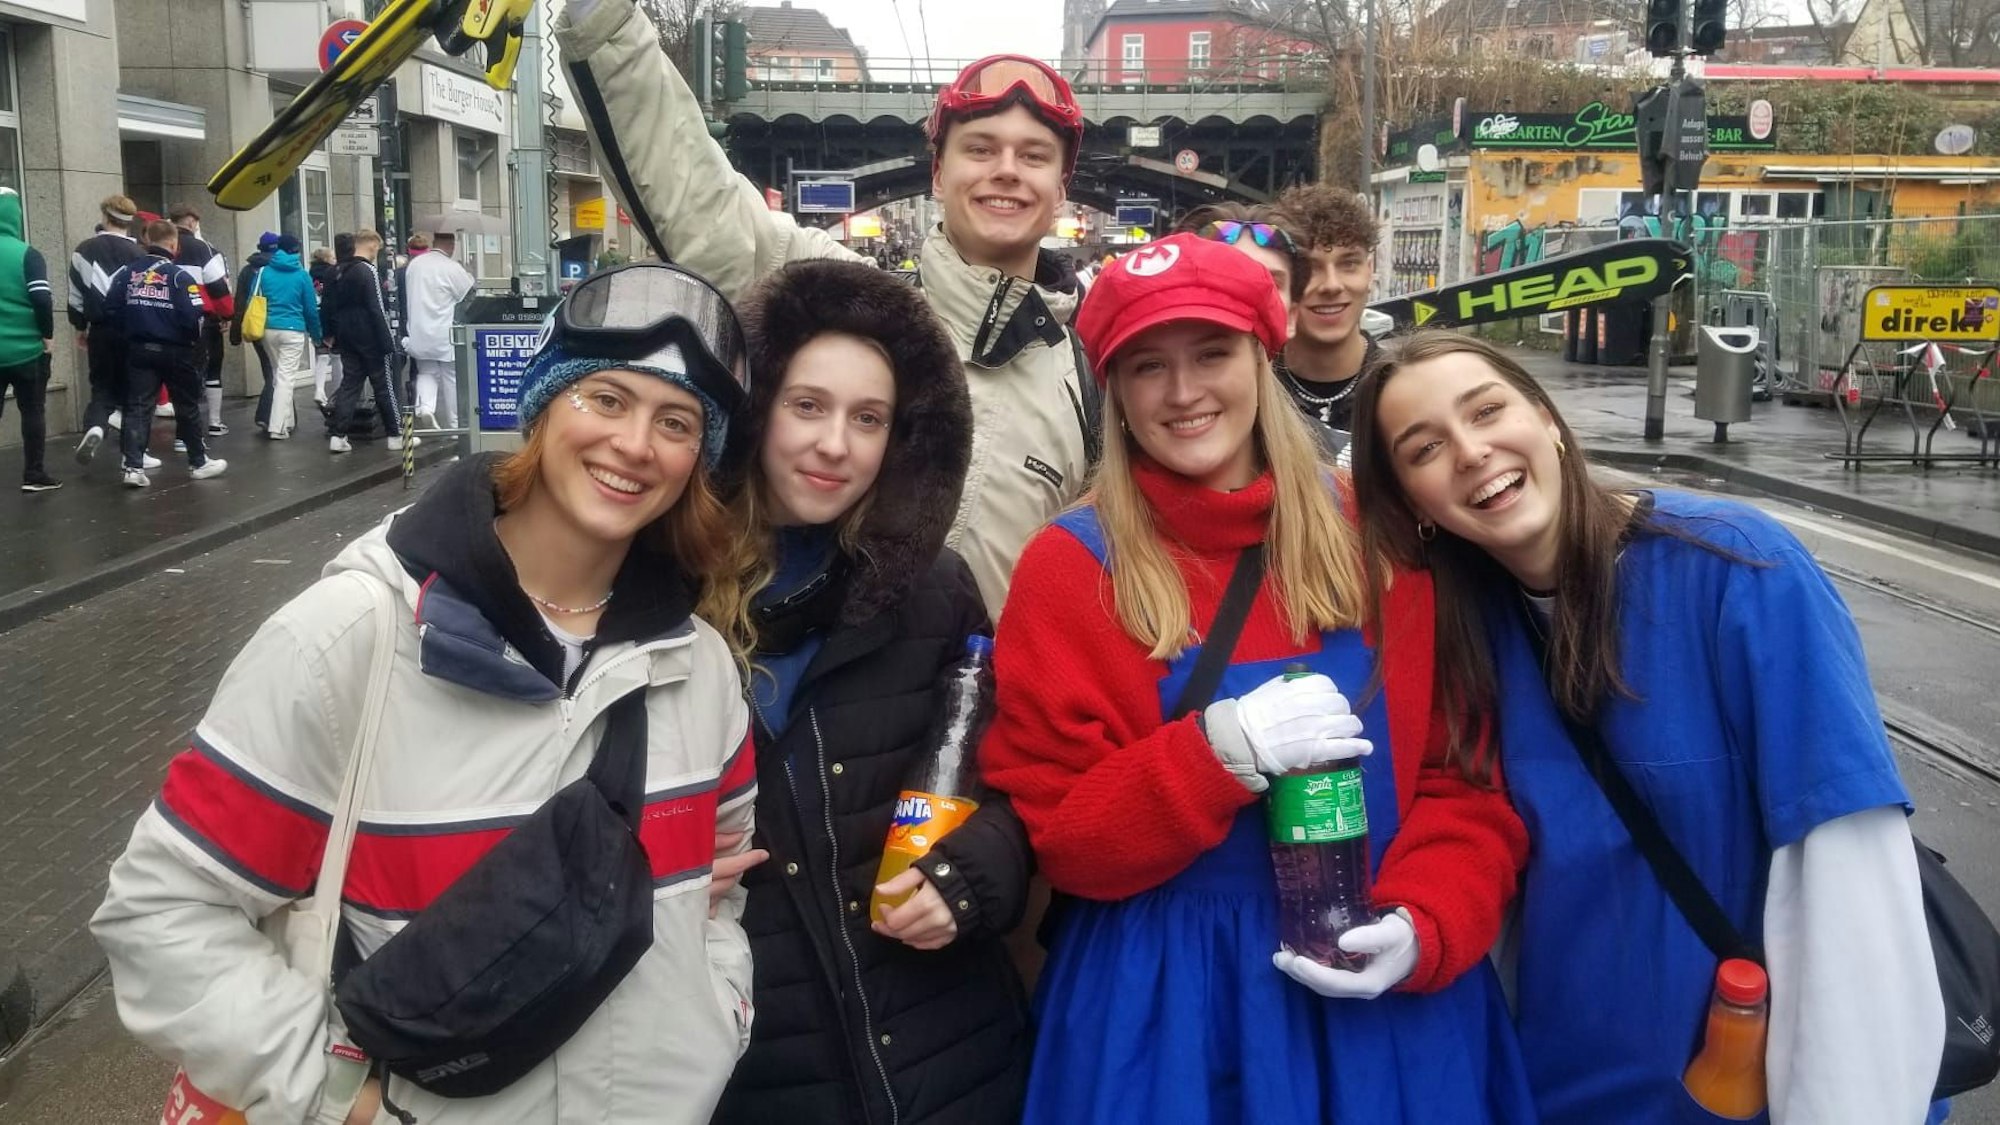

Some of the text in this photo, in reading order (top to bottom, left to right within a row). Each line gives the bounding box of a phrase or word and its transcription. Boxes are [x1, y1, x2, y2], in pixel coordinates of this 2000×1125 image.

[430, 72, 446, 99] The
[449, 79, 472, 113] Burger
[474, 87, 495, 114] House
[1133, 246, 1172, 269] M
[569, 264, 582, 280] P
[1458, 256, 1659, 320] HEAD
[1307, 779, 1332, 792] Sprite
[893, 797, 932, 819] ANTA
